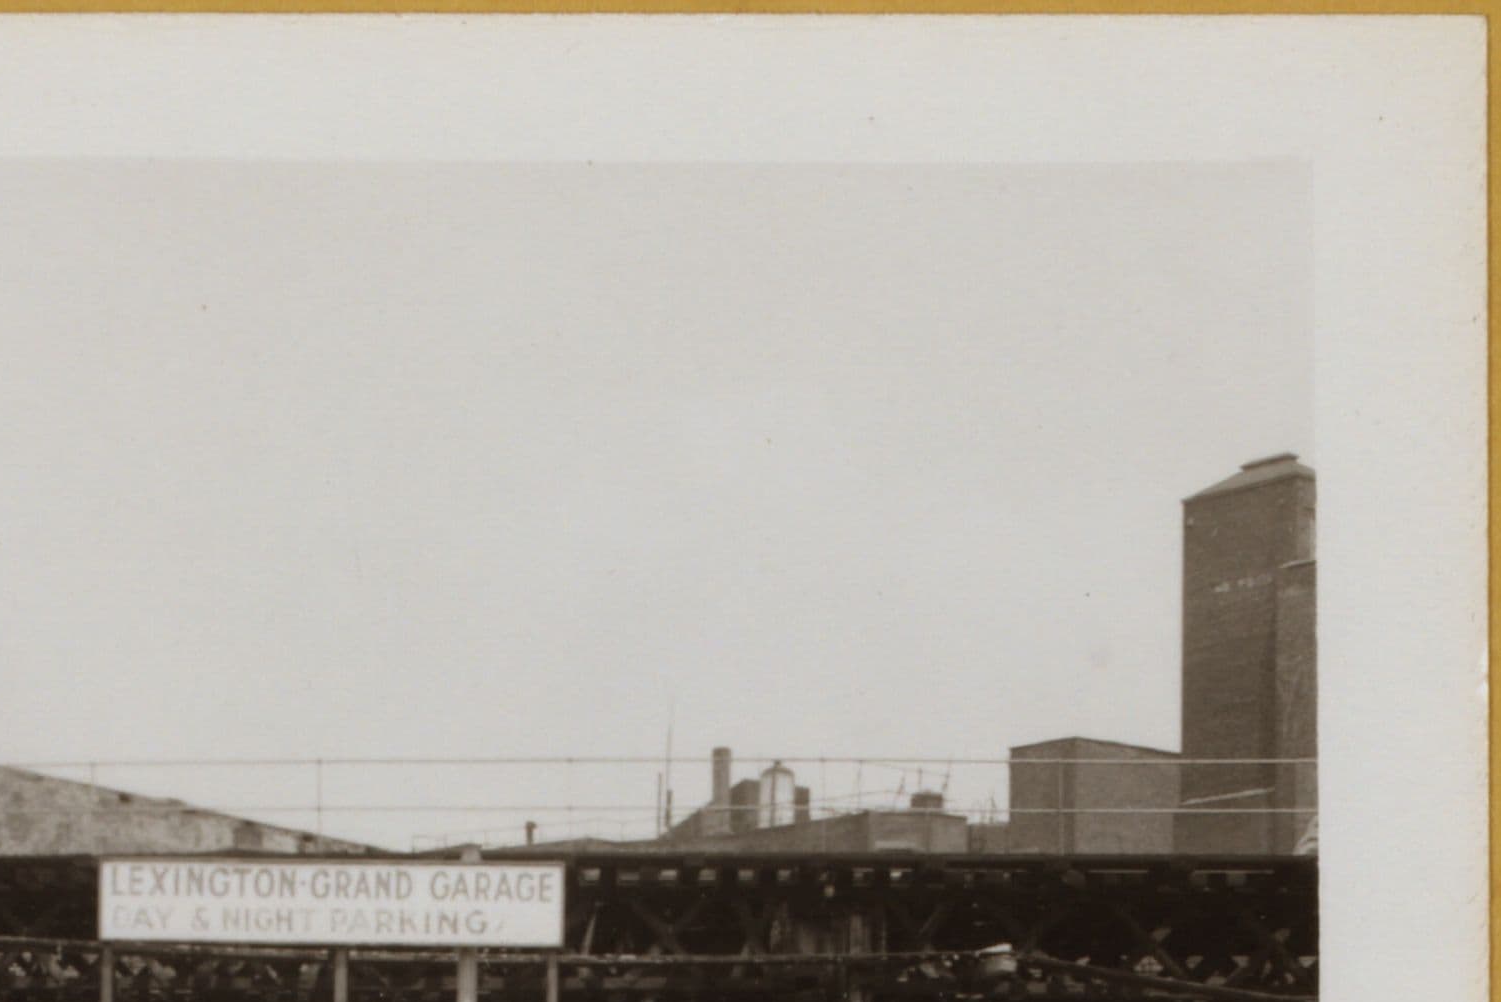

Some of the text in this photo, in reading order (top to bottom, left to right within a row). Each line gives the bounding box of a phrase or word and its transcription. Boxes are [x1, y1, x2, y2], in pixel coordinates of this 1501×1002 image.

[428, 869, 554, 904] GARAGE
[111, 903, 490, 937] DAY & NIGHT PARKING
